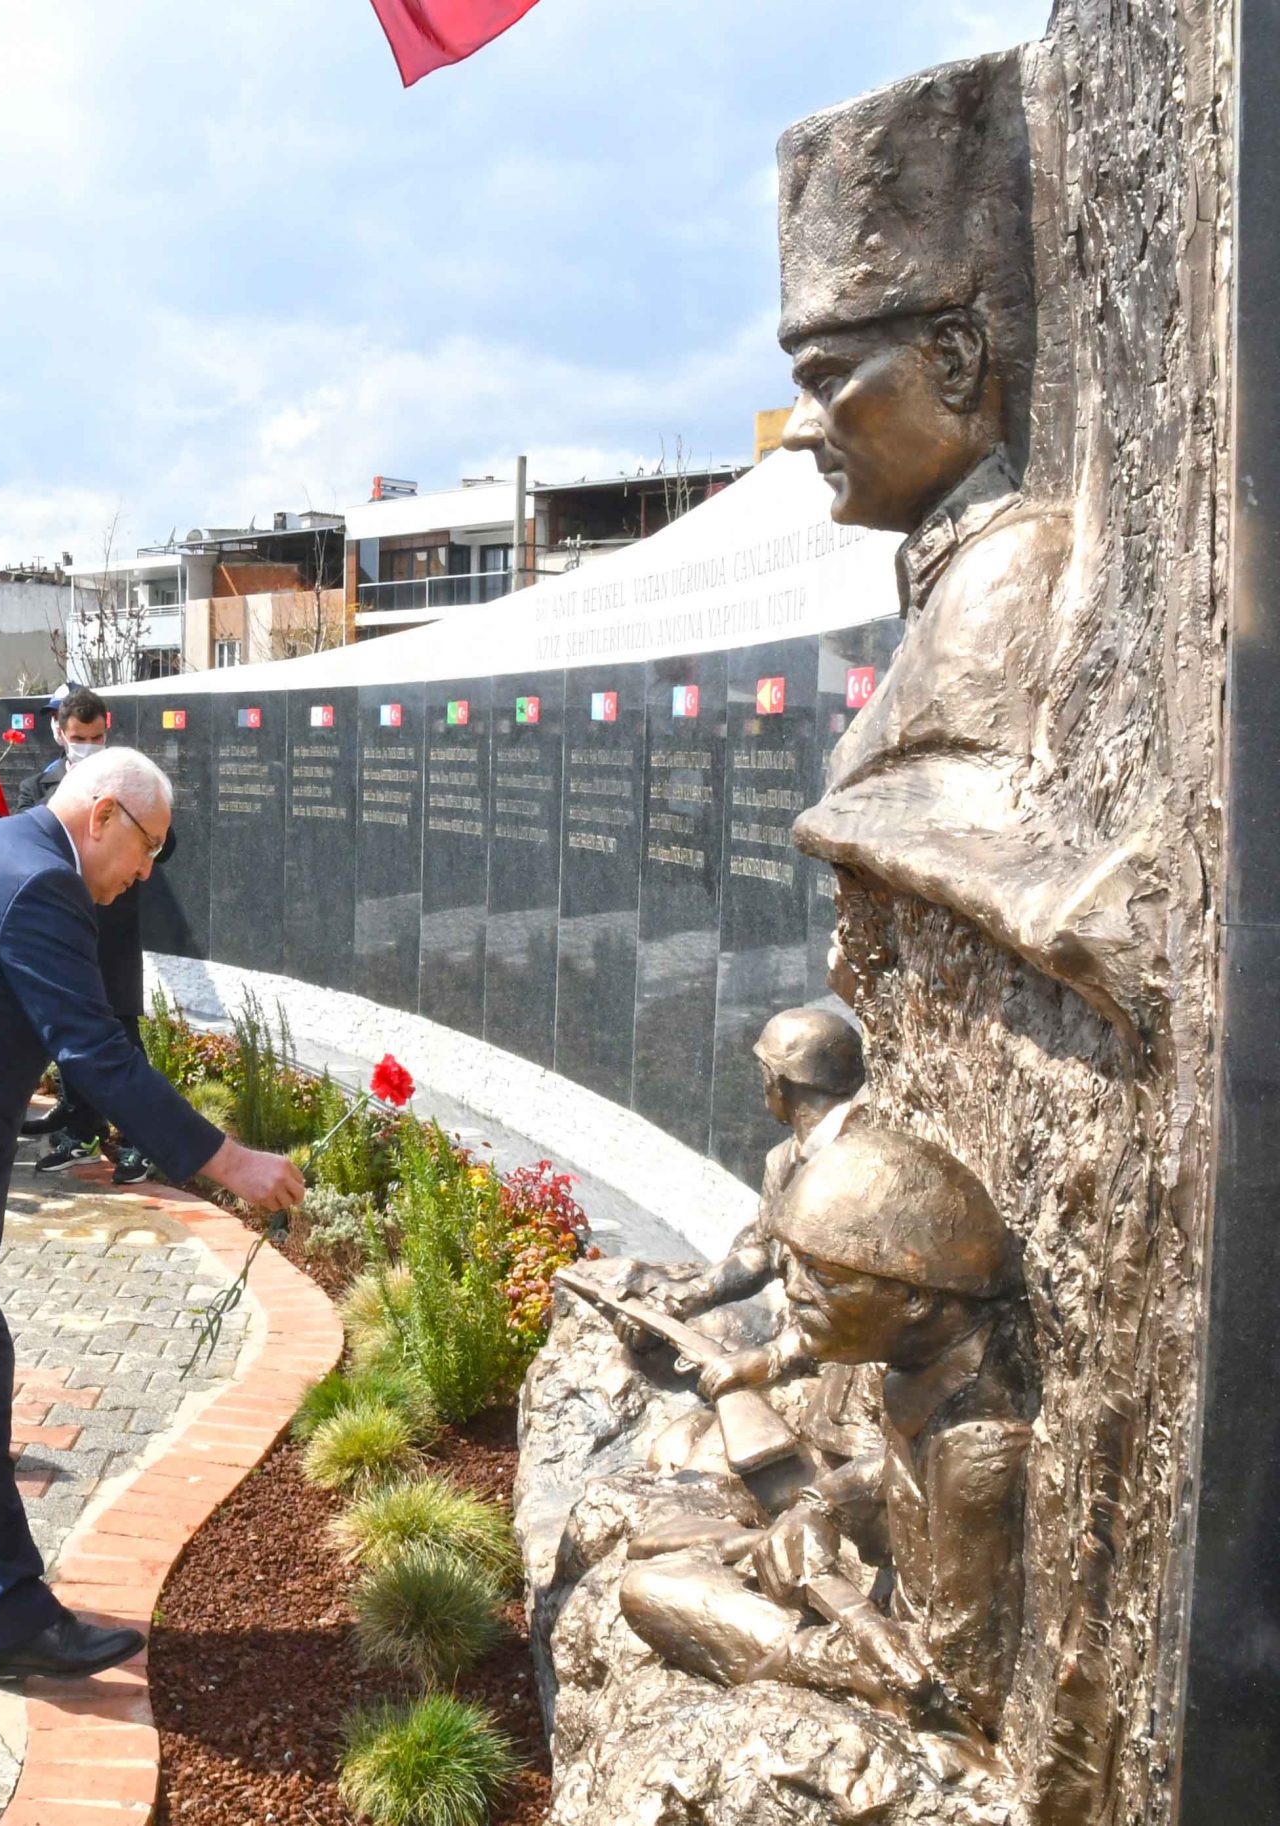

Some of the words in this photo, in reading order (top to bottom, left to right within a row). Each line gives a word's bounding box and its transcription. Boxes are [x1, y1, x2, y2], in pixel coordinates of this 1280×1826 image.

[582, 582, 626, 615] HEYKEL
[633, 572, 669, 604] VATAN
[671, 556, 726, 597] UĞRUNDA
[733, 530, 800, 582] CANLARINI
[806, 518, 835, 561] FEDA
[839, 525, 870, 549] ED
[656, 611, 704, 648] ANISINA
